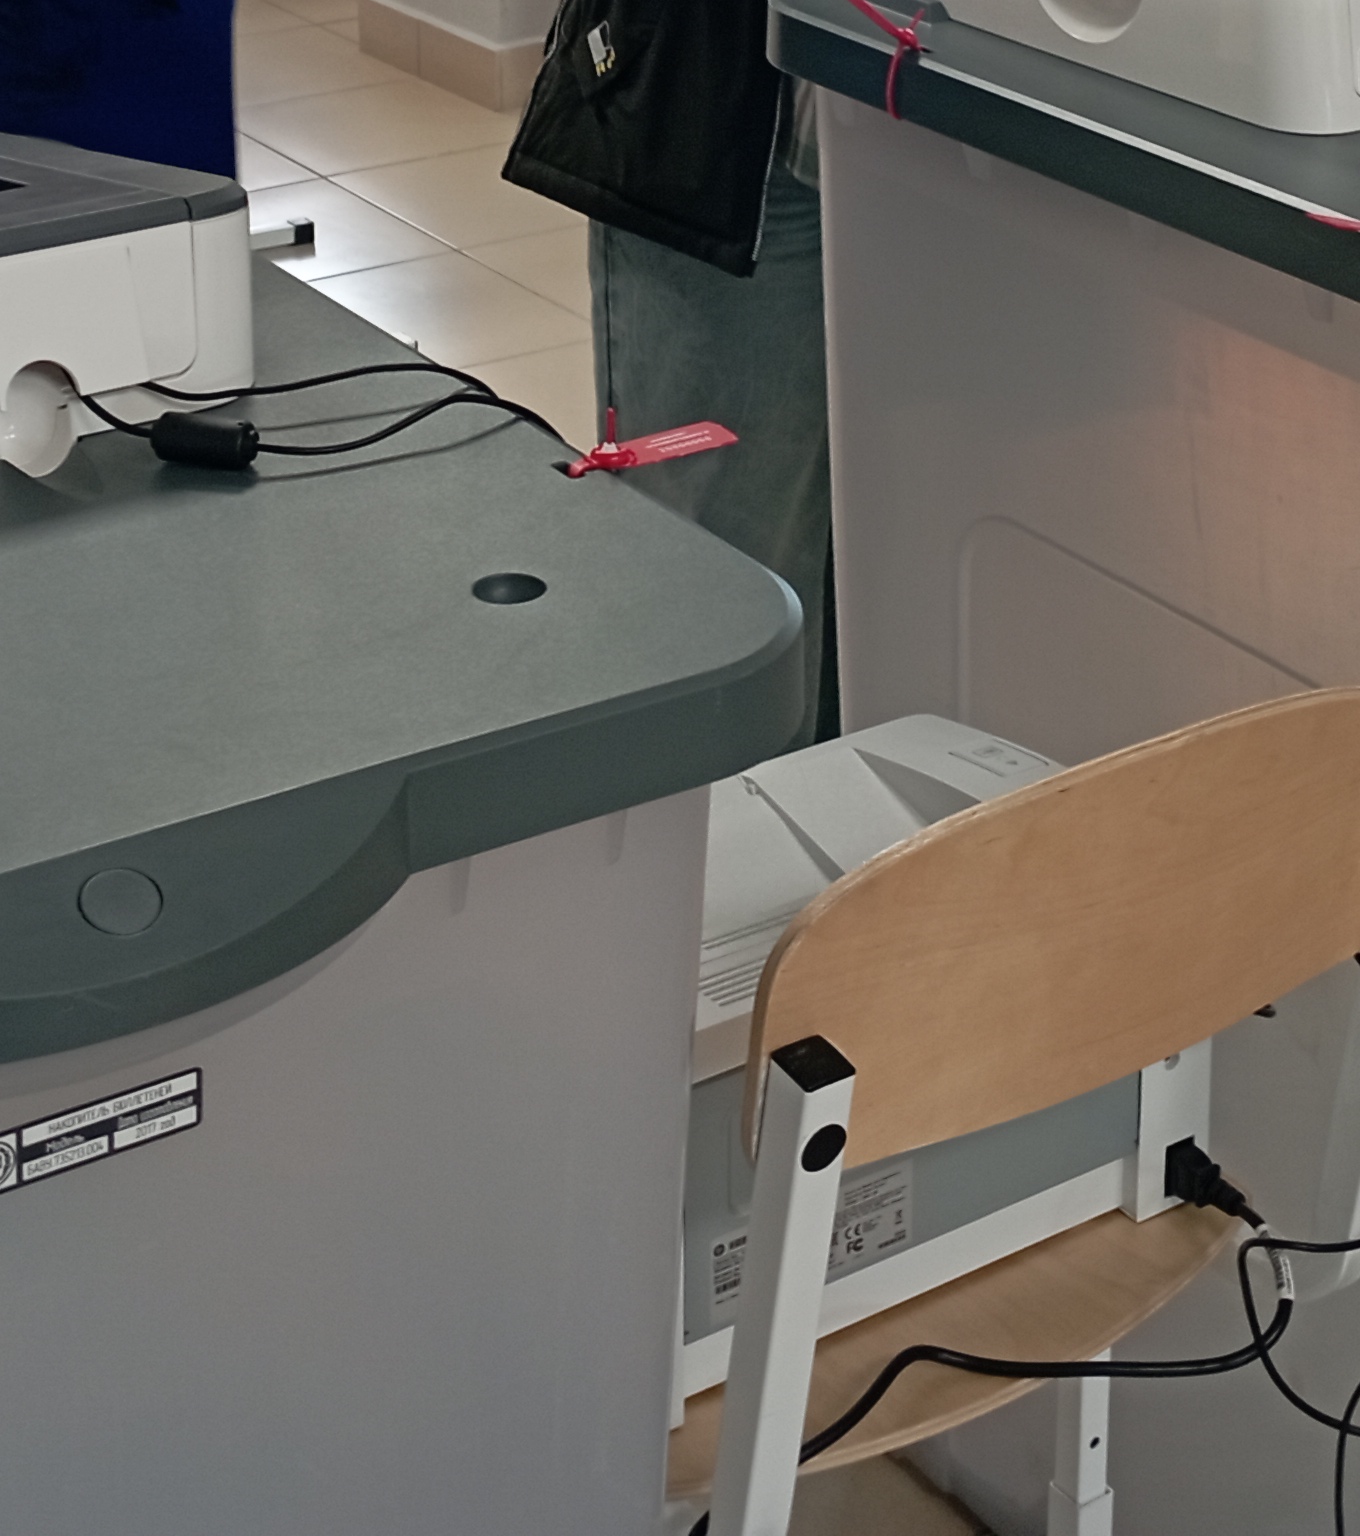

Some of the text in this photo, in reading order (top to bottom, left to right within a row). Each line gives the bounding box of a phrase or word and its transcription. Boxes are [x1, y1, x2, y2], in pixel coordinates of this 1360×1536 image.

[47, 1083, 173, 1134] НАКОПИТЕЛЬ БЮЛЛЕТЕНЕЙ
[135, 1123, 157, 1139] 2017
